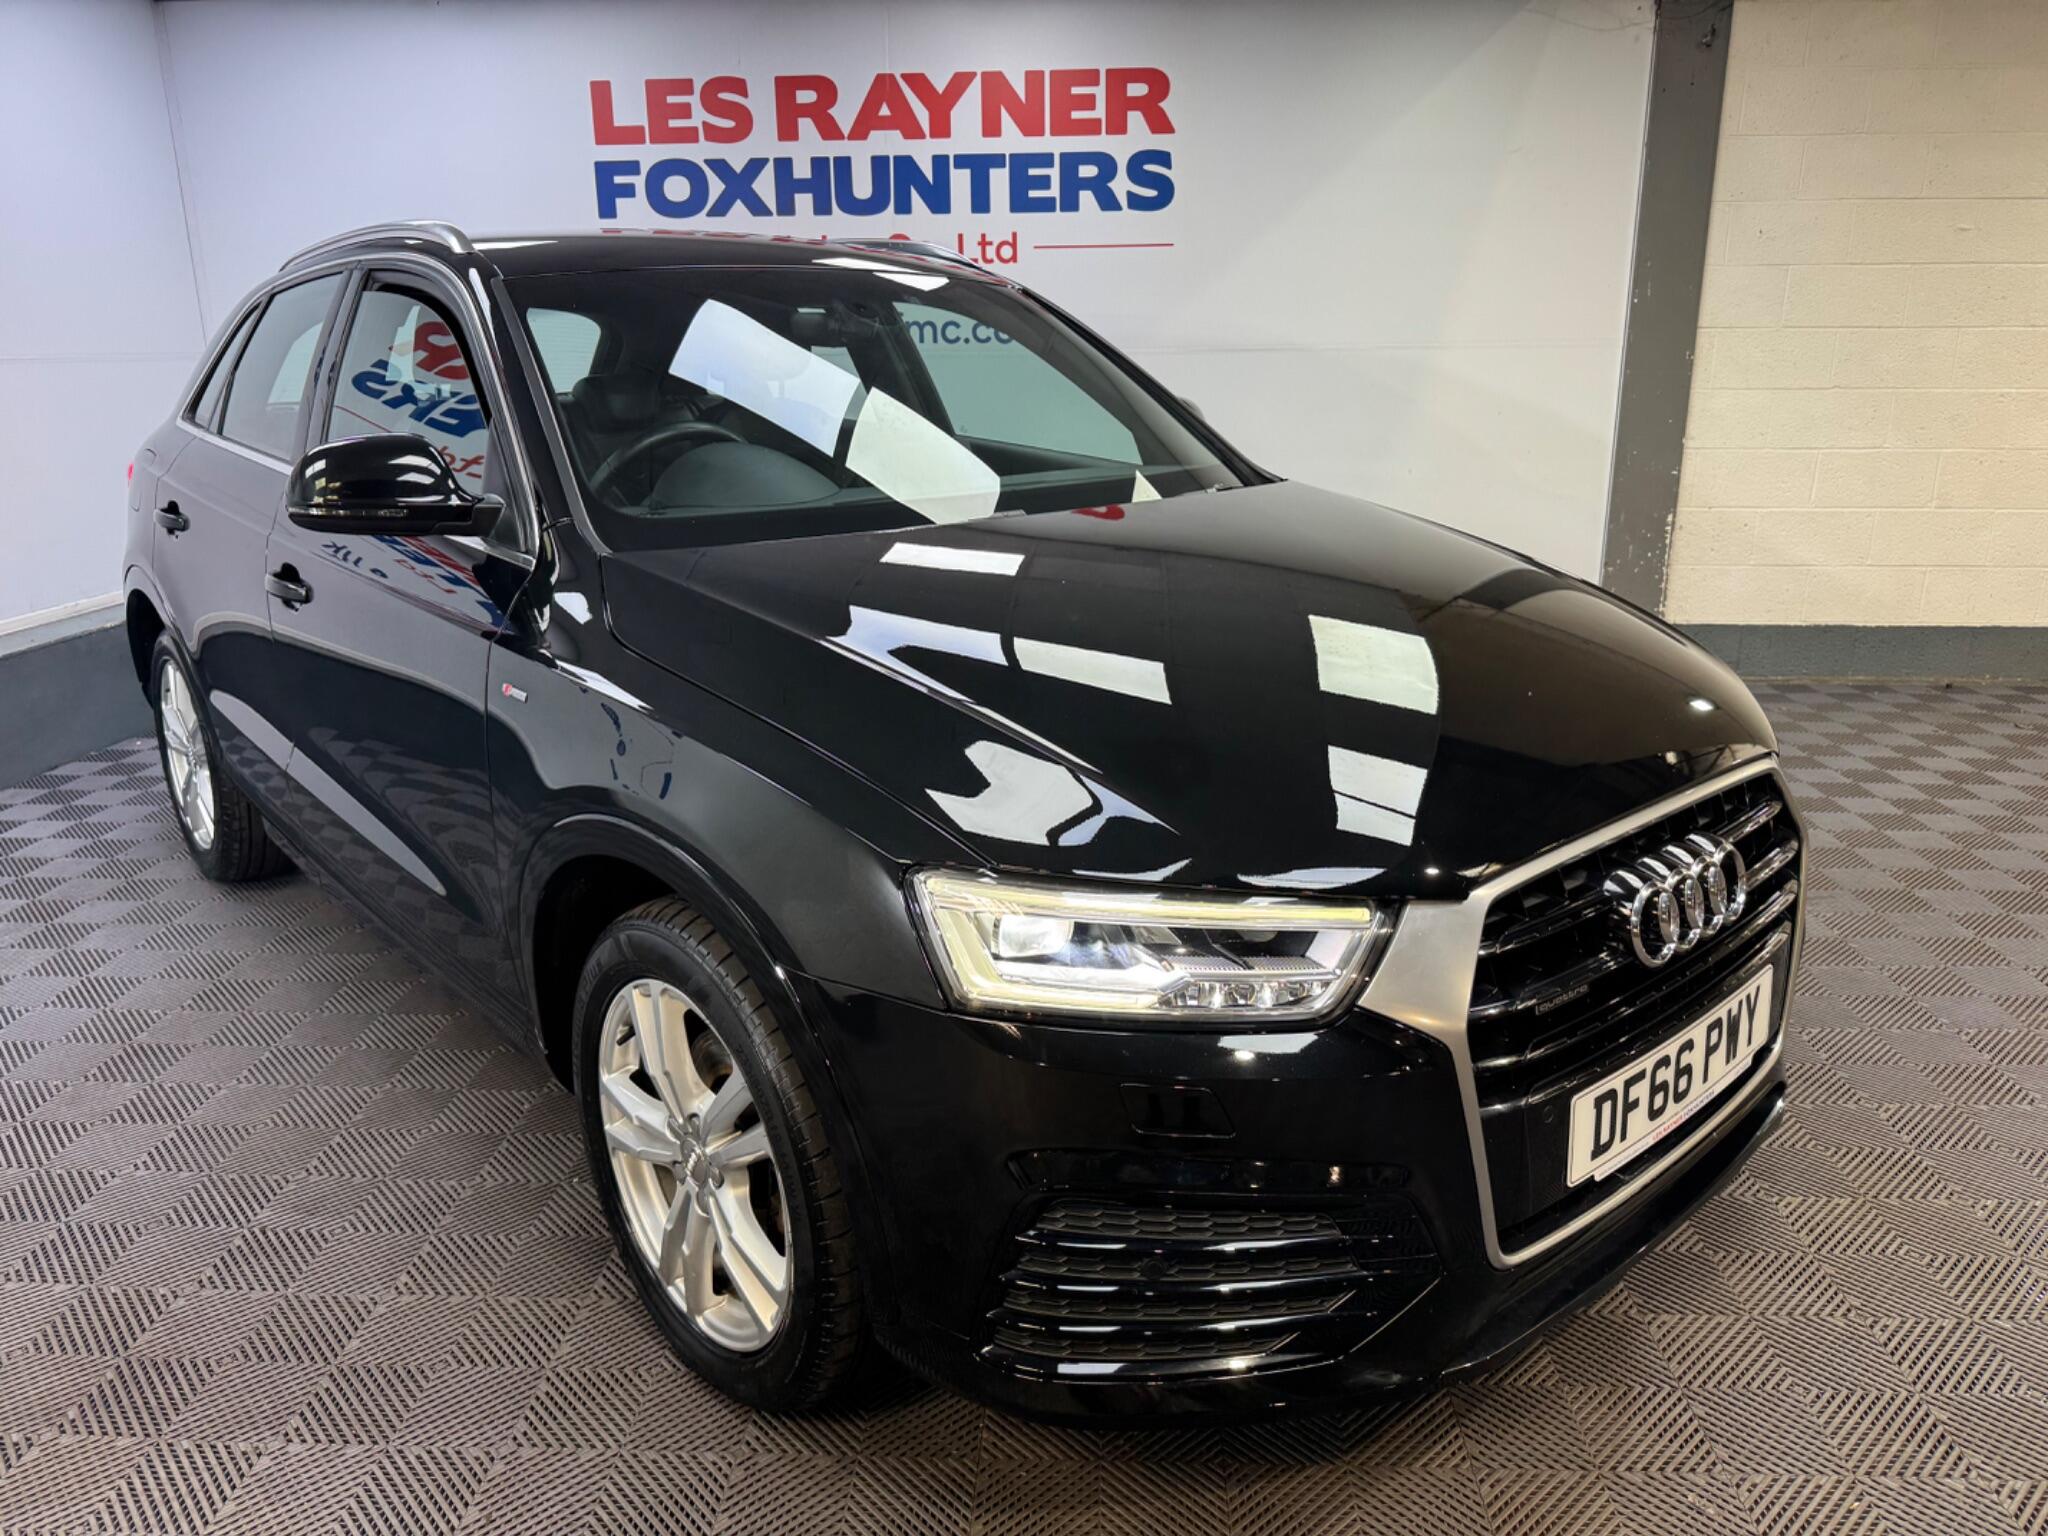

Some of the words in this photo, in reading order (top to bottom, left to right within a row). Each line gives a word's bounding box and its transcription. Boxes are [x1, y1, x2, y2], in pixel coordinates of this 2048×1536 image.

[590, 76, 754, 145] LES
[774, 67, 1175, 142] RAYNER
[594, 149, 1175, 219] FOXHUNTERS
[956, 231, 1018, 264] Ltd
[1590, 1037, 1695, 1162] DF66
[1702, 985, 1761, 1085] PWY
